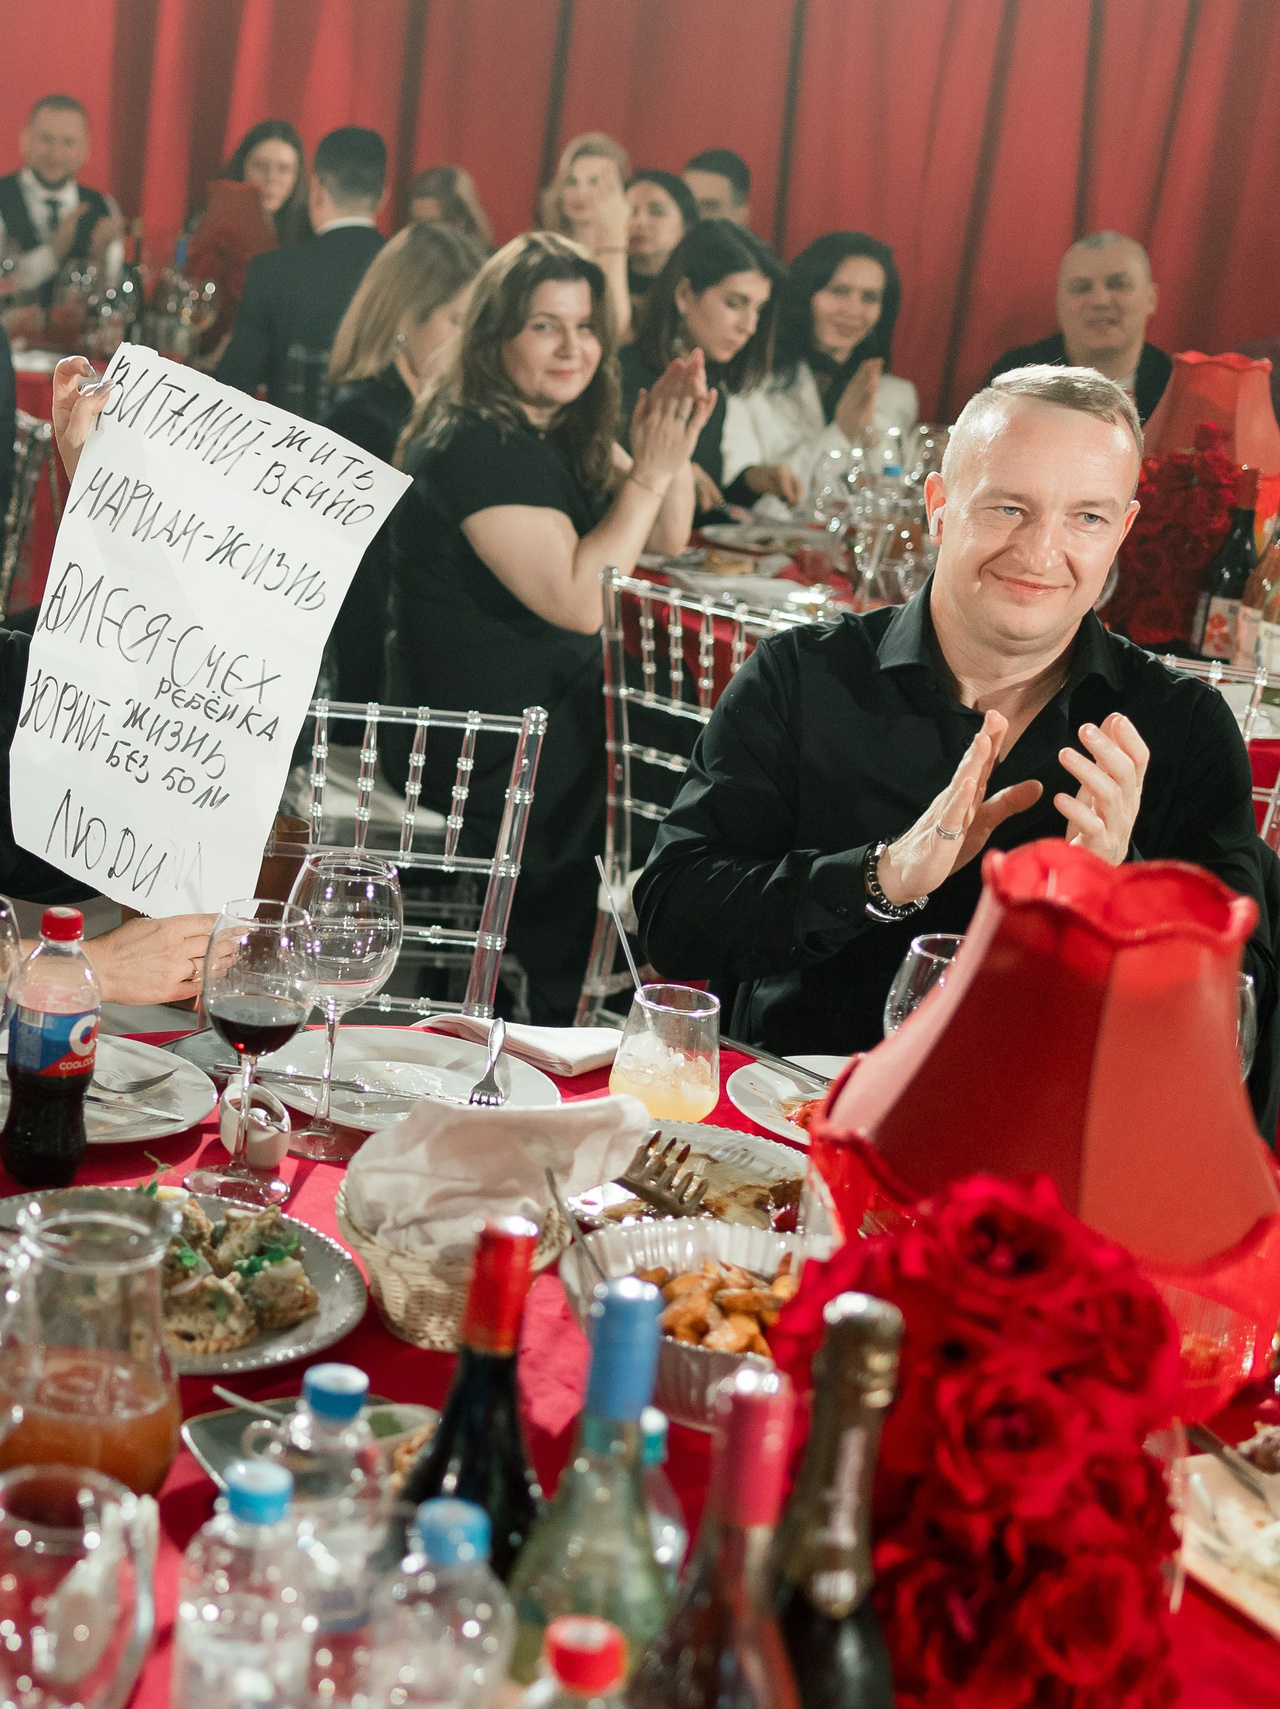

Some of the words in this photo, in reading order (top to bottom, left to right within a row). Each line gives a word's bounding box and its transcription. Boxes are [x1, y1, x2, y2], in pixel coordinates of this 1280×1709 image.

[271, 425, 375, 491] ЖИТЬ
[253, 461, 375, 526] ВЕЧНО
[122, 698, 226, 780] ЖИЗНЬ
[154, 677, 279, 742] РЕБЁНКА
[105, 740, 149, 783] БЕЗ
[161, 766, 231, 810] БОЛИ
[45, 788, 168, 899] ЛЮДИ
